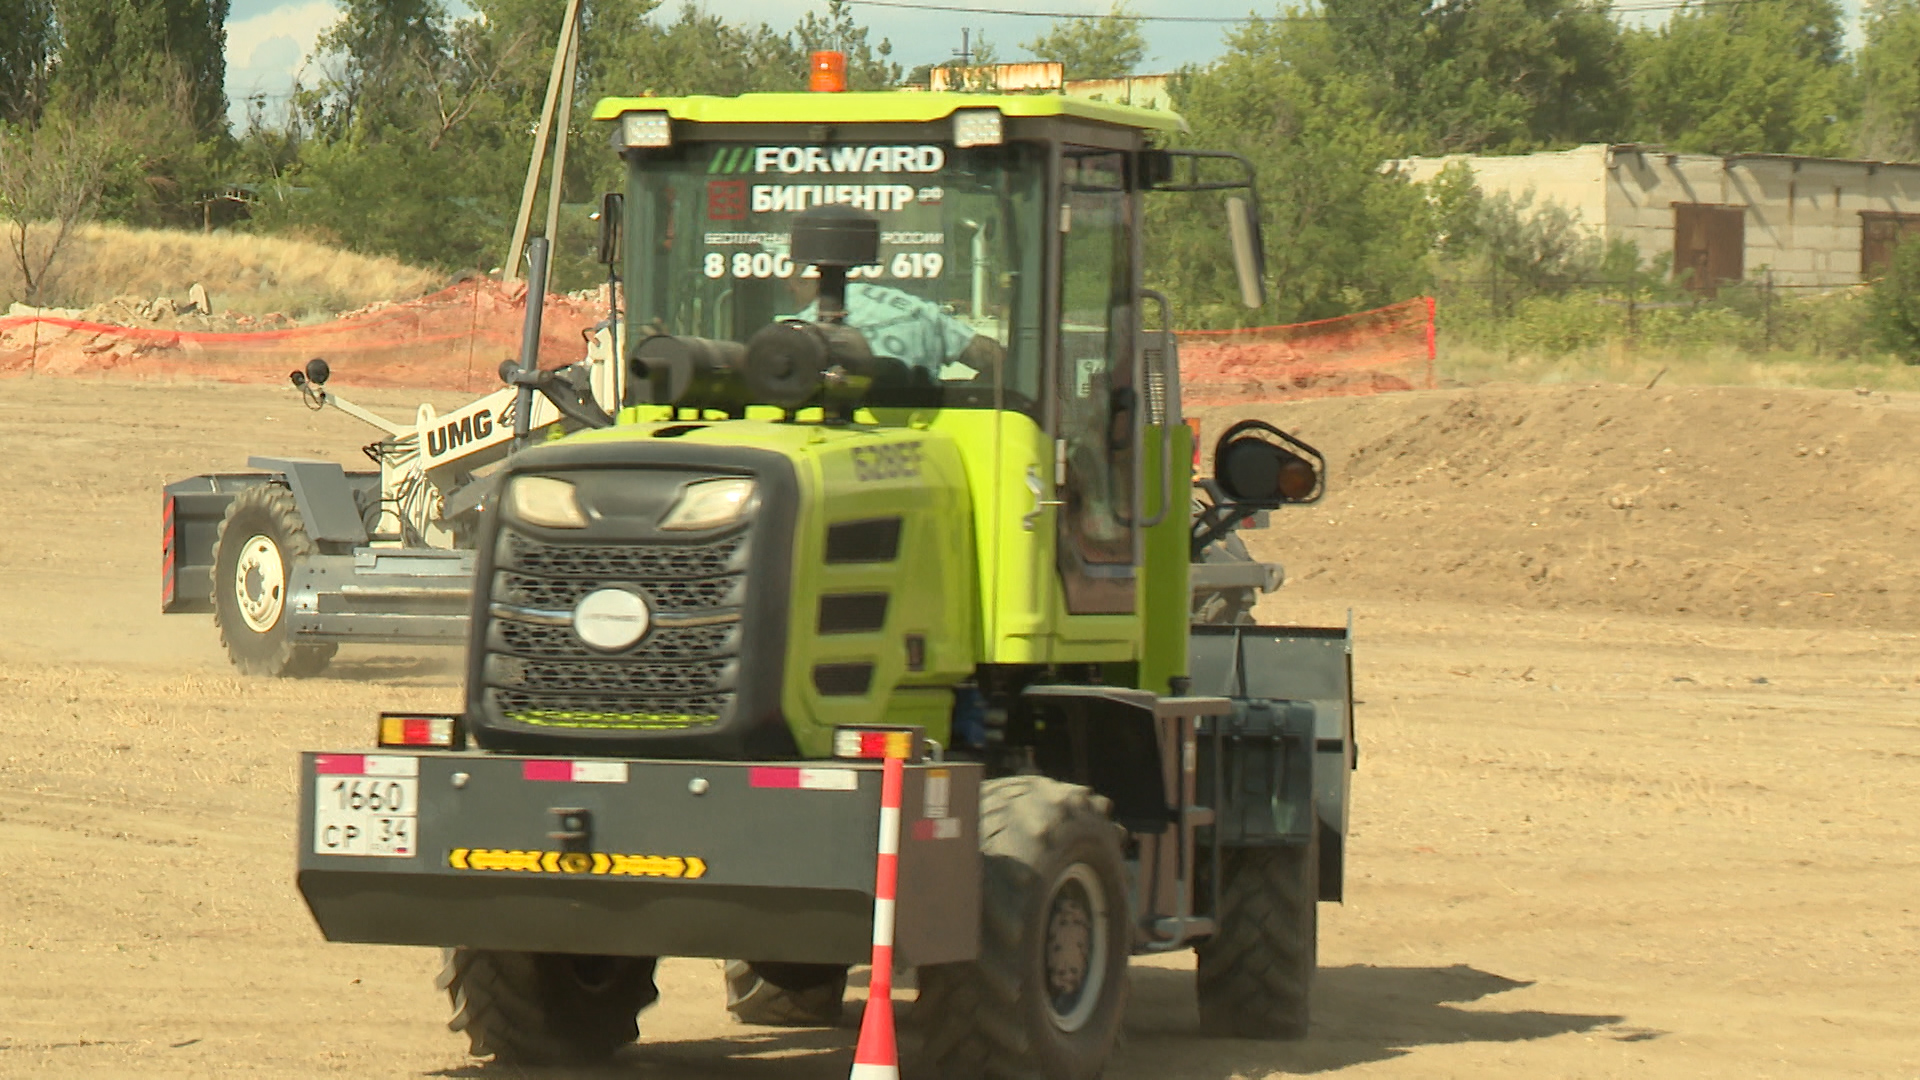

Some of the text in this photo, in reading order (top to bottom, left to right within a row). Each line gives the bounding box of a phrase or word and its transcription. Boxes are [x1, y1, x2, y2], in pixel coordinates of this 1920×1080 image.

[754, 147, 945, 173] FORWARD
[704, 252, 725, 279] 8
[732, 252, 796, 279] 800
[891, 252, 944, 279] 619
[427, 408, 493, 458] UMG
[332, 780, 404, 812] 1660
[379, 819, 408, 844] 34
